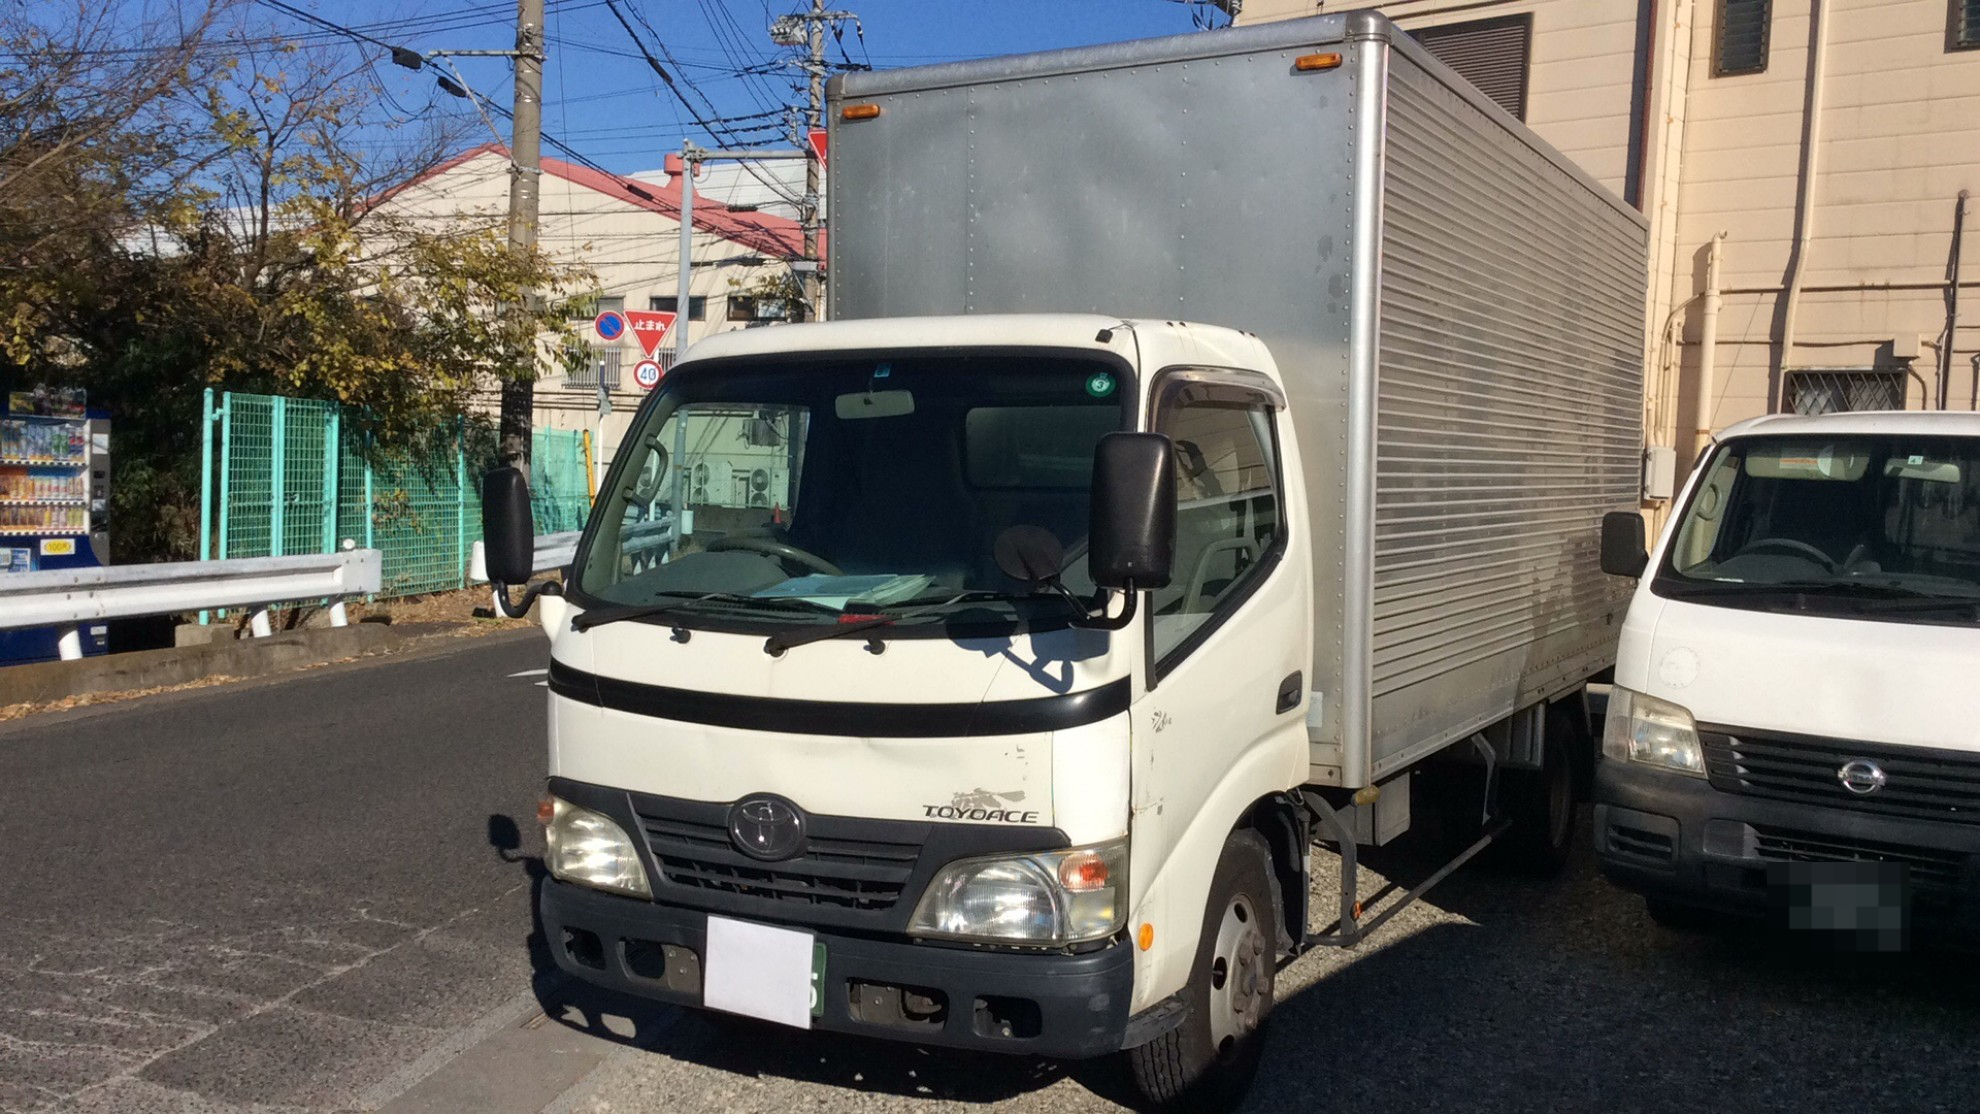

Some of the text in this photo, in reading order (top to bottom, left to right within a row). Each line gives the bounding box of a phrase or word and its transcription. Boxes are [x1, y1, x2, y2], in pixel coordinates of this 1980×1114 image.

[634, 319, 666, 332] 止まれ
[640, 367, 657, 381] 40
[922, 804, 1040, 824] TOYOACE
